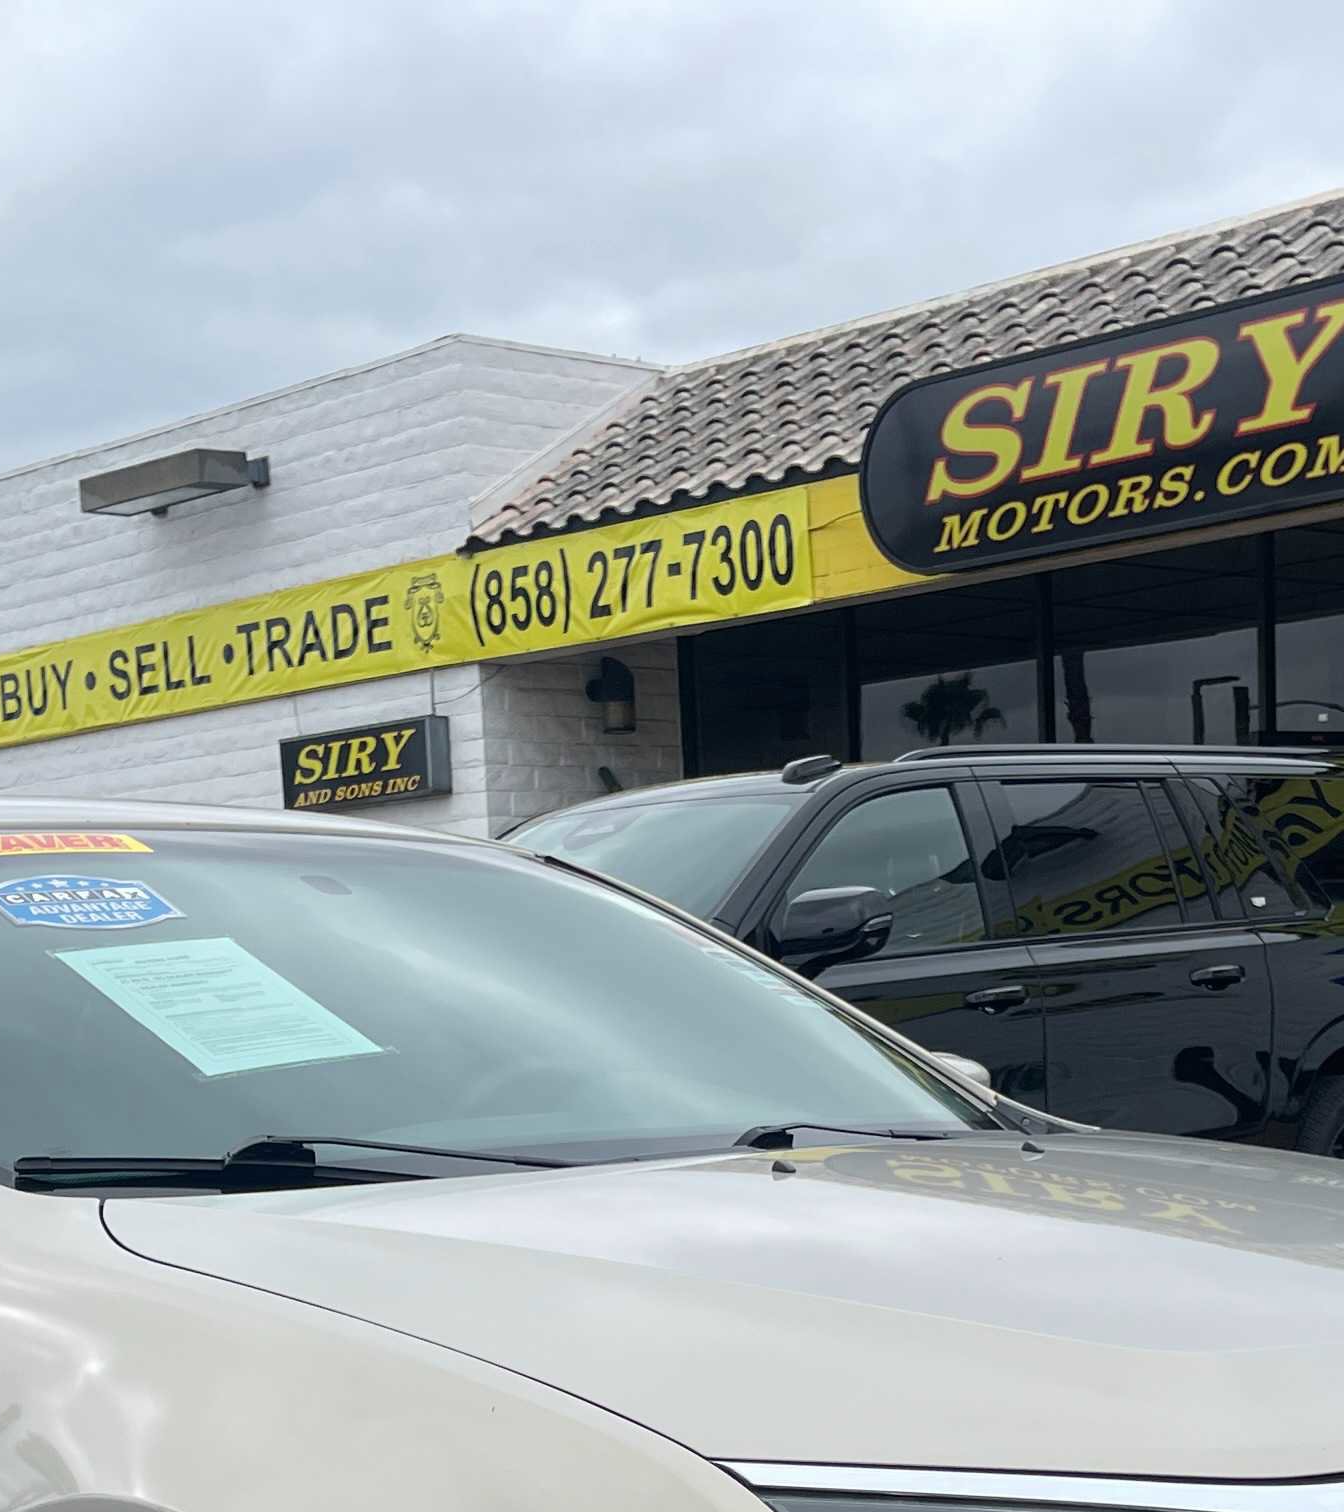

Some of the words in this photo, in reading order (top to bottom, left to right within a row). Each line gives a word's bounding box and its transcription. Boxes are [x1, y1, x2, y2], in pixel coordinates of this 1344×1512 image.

[468, 548, 572, 646] (858)
[587, 512, 795, 620] 277-7300
[0, 658, 72, 722] BUY
[109, 633, 212, 701] SELL
[236, 594, 394, 677] TRADE
[293, 728, 417, 785] SIRY
[293, 788, 332, 808] AND
[335, 780, 383, 802] SONS
[385, 775, 421, 795] INC
[4, 886, 146, 905] CARFAX
[28, 900, 153, 917] ADVANTAGE
[60, 911, 144, 925] DEALER
